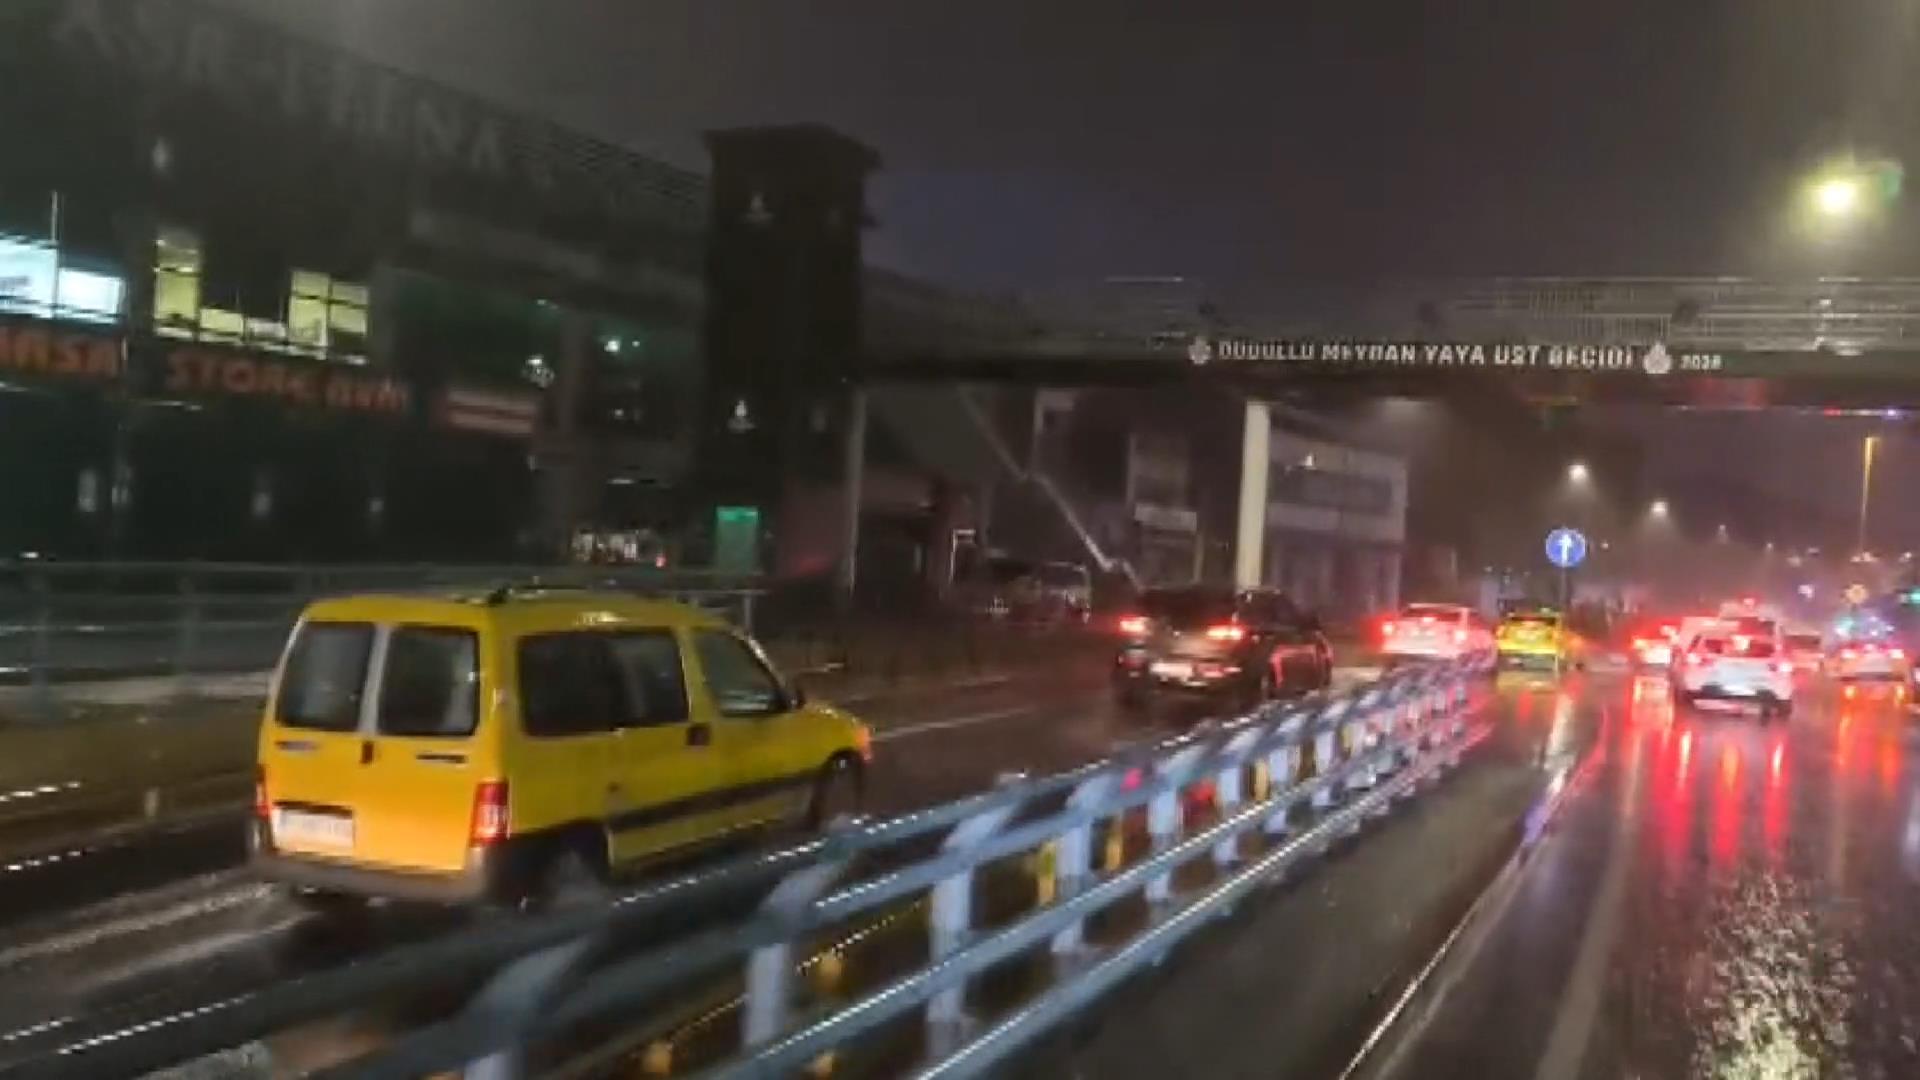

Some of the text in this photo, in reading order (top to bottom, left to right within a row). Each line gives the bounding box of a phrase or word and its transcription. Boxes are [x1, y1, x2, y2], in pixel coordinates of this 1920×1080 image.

[1218, 341, 1315, 361] DUDULLU
[1322, 342, 1416, 363] MEYDAN
[1423, 344, 1485, 365] YAYA
